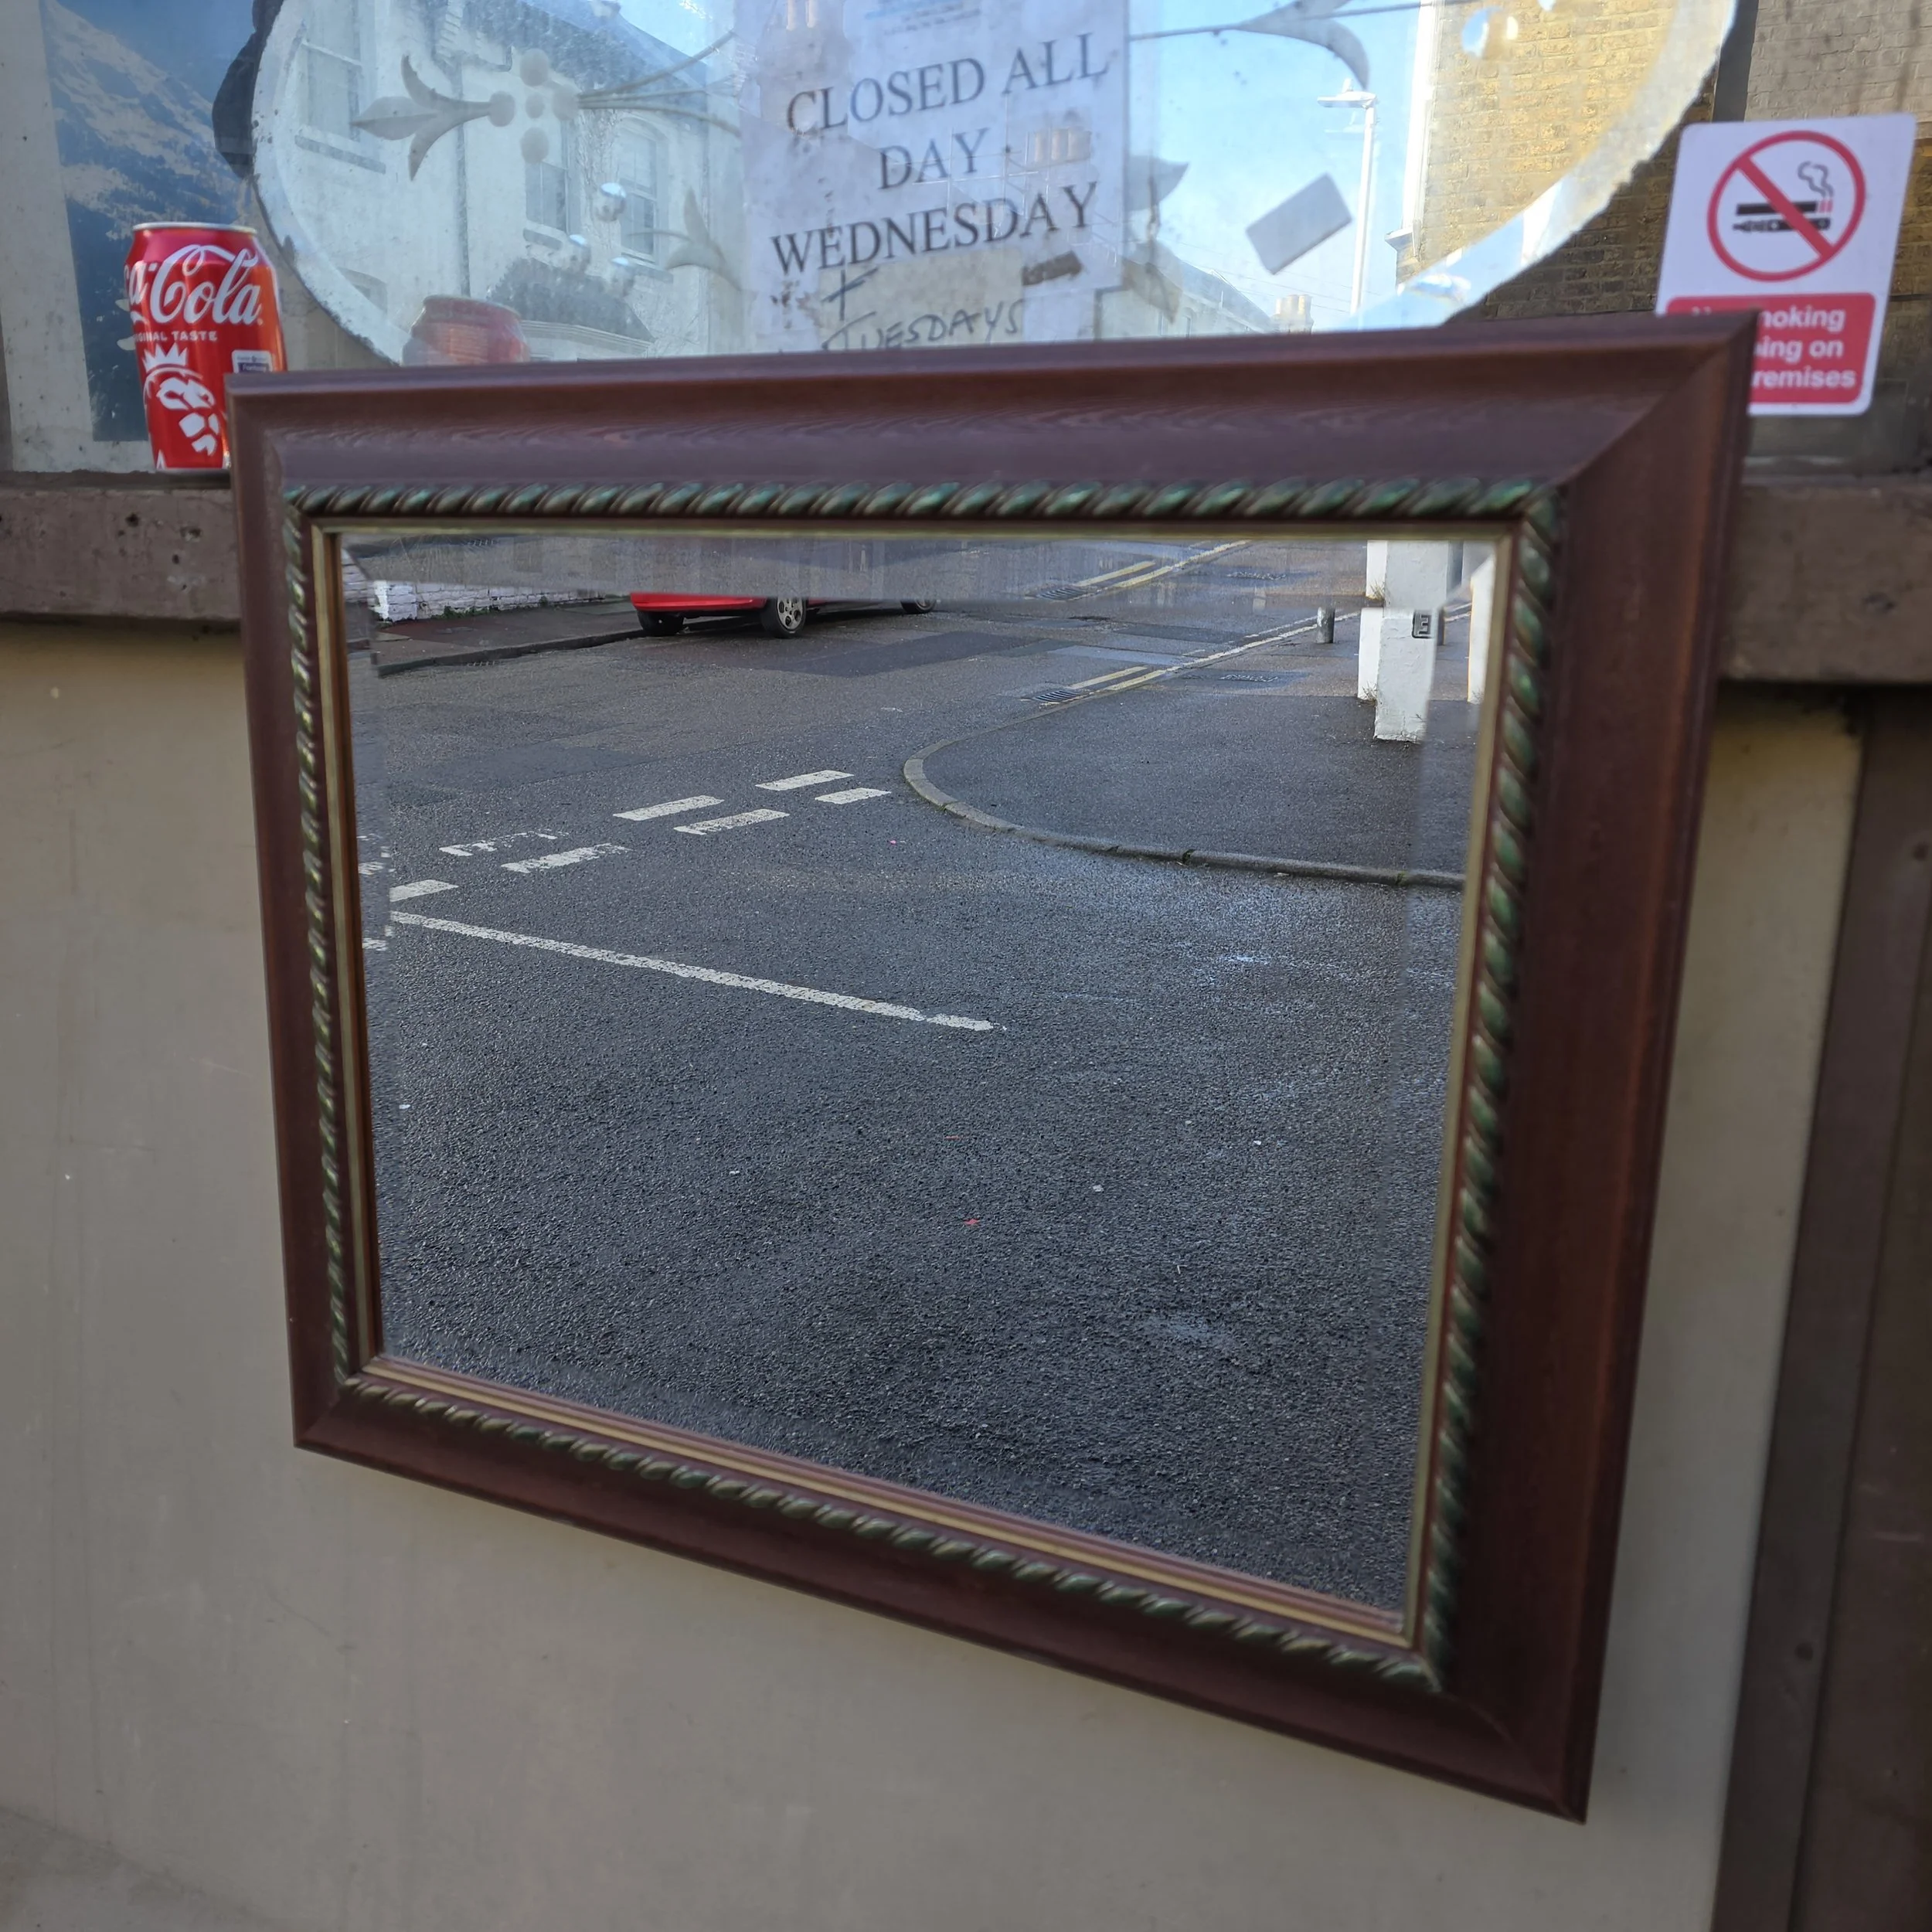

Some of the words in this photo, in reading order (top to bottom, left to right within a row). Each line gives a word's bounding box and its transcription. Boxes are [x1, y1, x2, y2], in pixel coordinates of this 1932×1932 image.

[786, 57, 986, 137] CLOSED
[1001, 32, 1110, 95] ALL
[877, 128, 990, 190] DAY
[768, 181, 1097, 275] WEDNESDAY
[124, 244, 263, 325] a-Cola
[172, 330, 218, 342] TASTE
[821, 298, 1026, 352] TUESDAYS
[1759, 304, 1846, 332] oking
[1753, 335, 1803, 364] ing
[1808, 339, 1844, 359] on
[1751, 366, 1857, 389] remises
